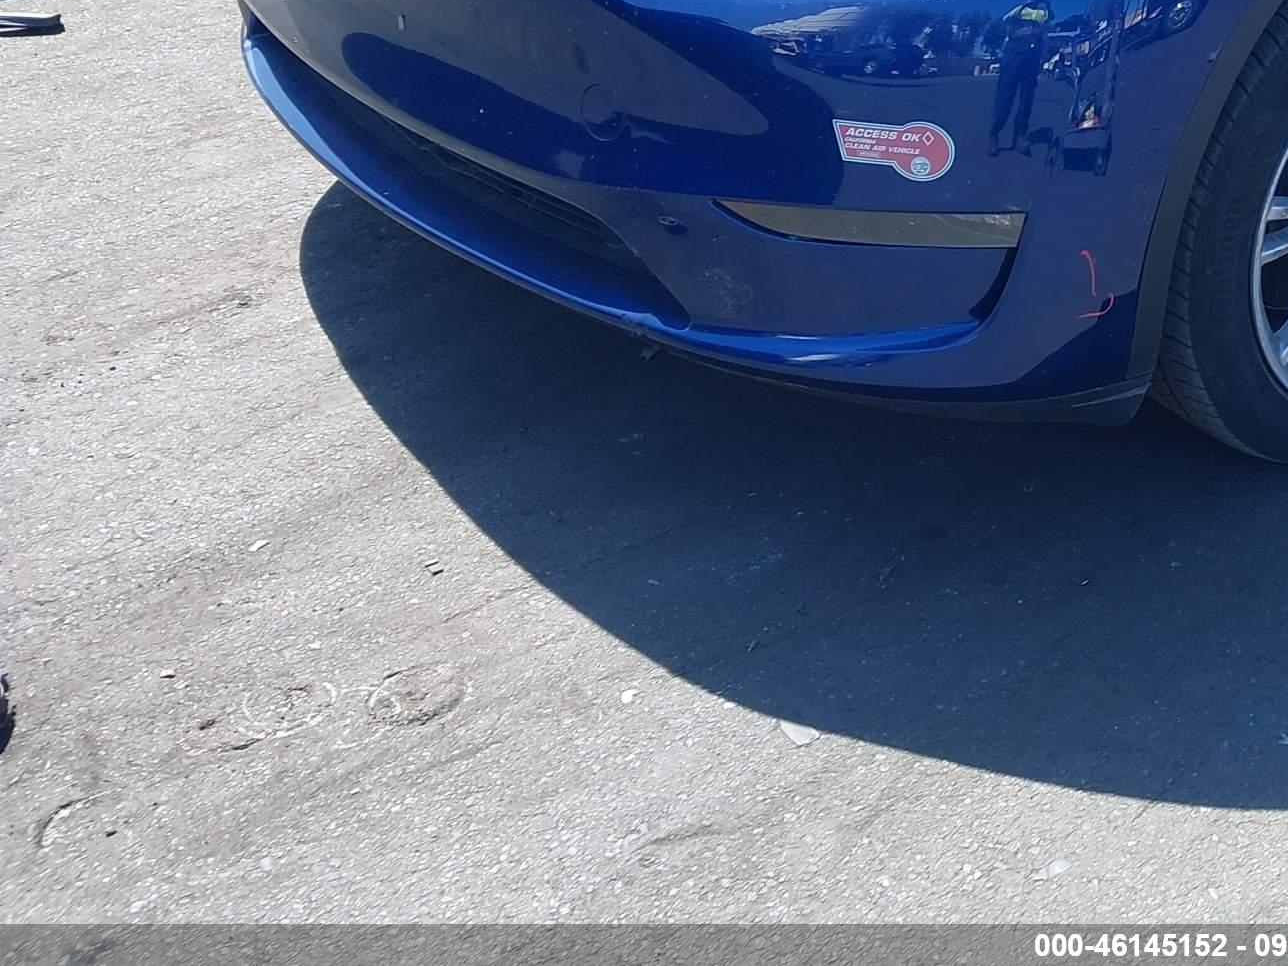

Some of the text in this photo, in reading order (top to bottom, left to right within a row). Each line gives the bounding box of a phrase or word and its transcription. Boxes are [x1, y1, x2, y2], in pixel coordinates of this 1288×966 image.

[846, 127, 922, 142] ACCESS OK
[844, 142, 870, 151] CLEAN
[871, 144, 886, 152] AIR
[888, 146, 921, 155] VEHICLE
